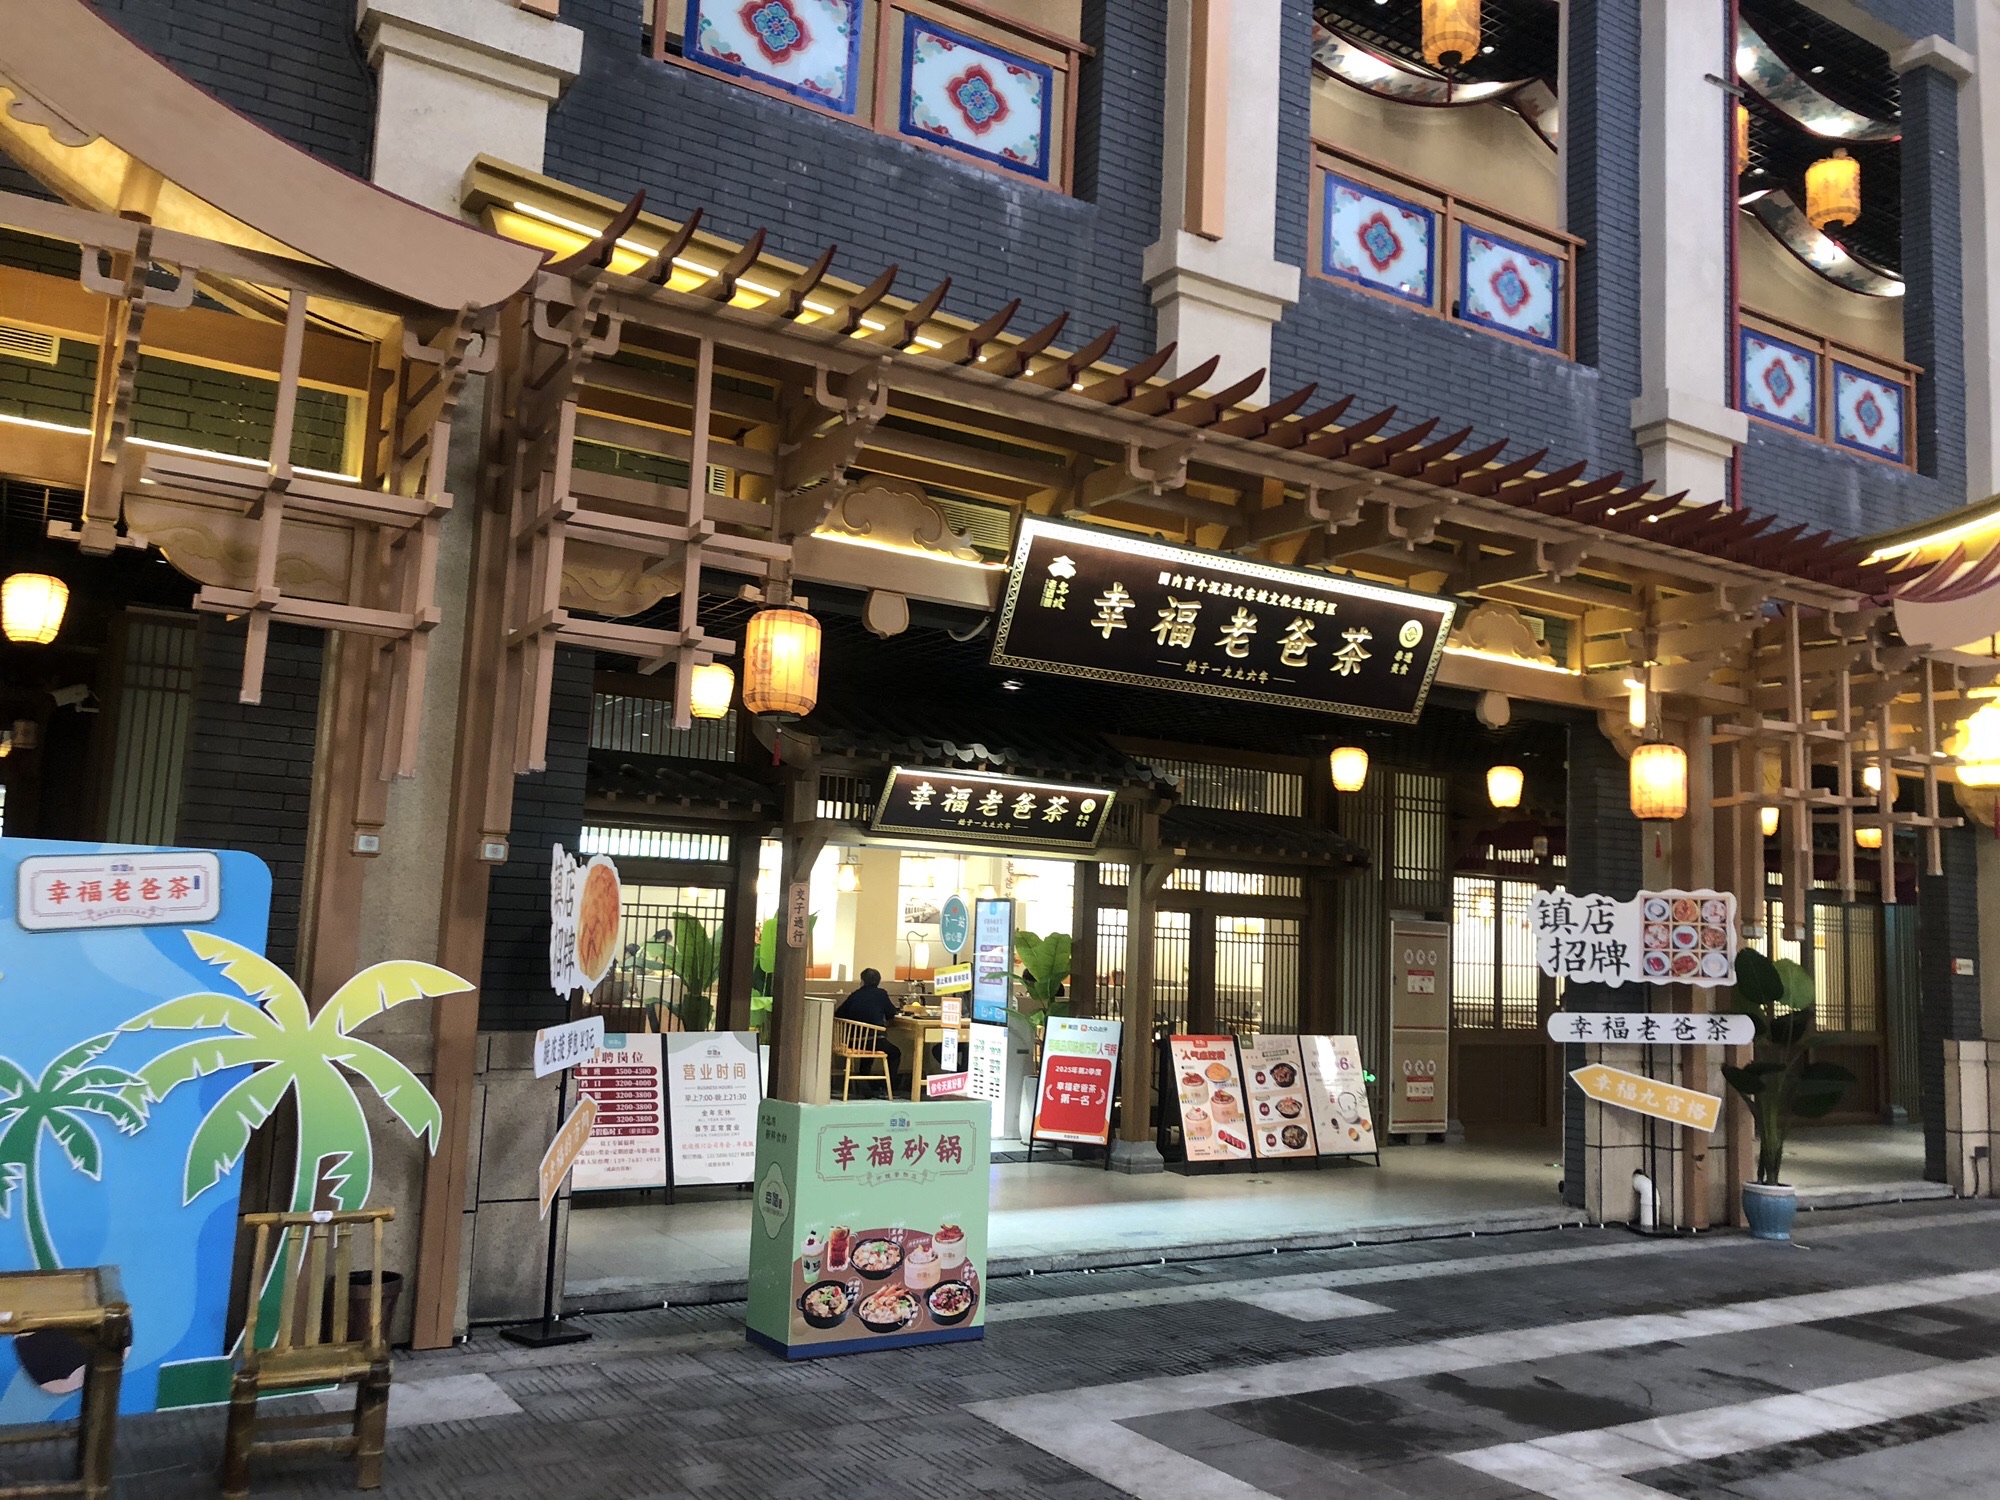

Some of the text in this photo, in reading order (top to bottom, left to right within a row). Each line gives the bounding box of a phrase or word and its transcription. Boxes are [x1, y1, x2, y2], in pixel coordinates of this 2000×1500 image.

[1090, 581, 1373, 677] 幸福老爸茶
[1185, 659, 1269, 684] 始于一九九六年
[908, 781, 1070, 823] 幸福老爸茶
[46, 875, 192, 905] 幸福老爸茶
[1537, 898, 1616, 936] 镇店
[1547, 938, 1631, 977] 招牌
[1569, 1015, 1732, 1042] 幸福老爸茶
[683, 1062, 746, 1080] 营业时间
[1055, 1065, 1103, 1077] 2025年第2季度
[685, 1093, 747, 1102] 早上7:00-晚上21:30
[1056, 1082, 1097, 1094] 幸福老爸茶
[1060, 1093, 1090, 1106] 第一名
[615, 1103, 652, 1111] 3200-3800
[695, 1124, 740, 1132] 春节正常营业
[832, 1134, 963, 1172] 幸福砂锅
